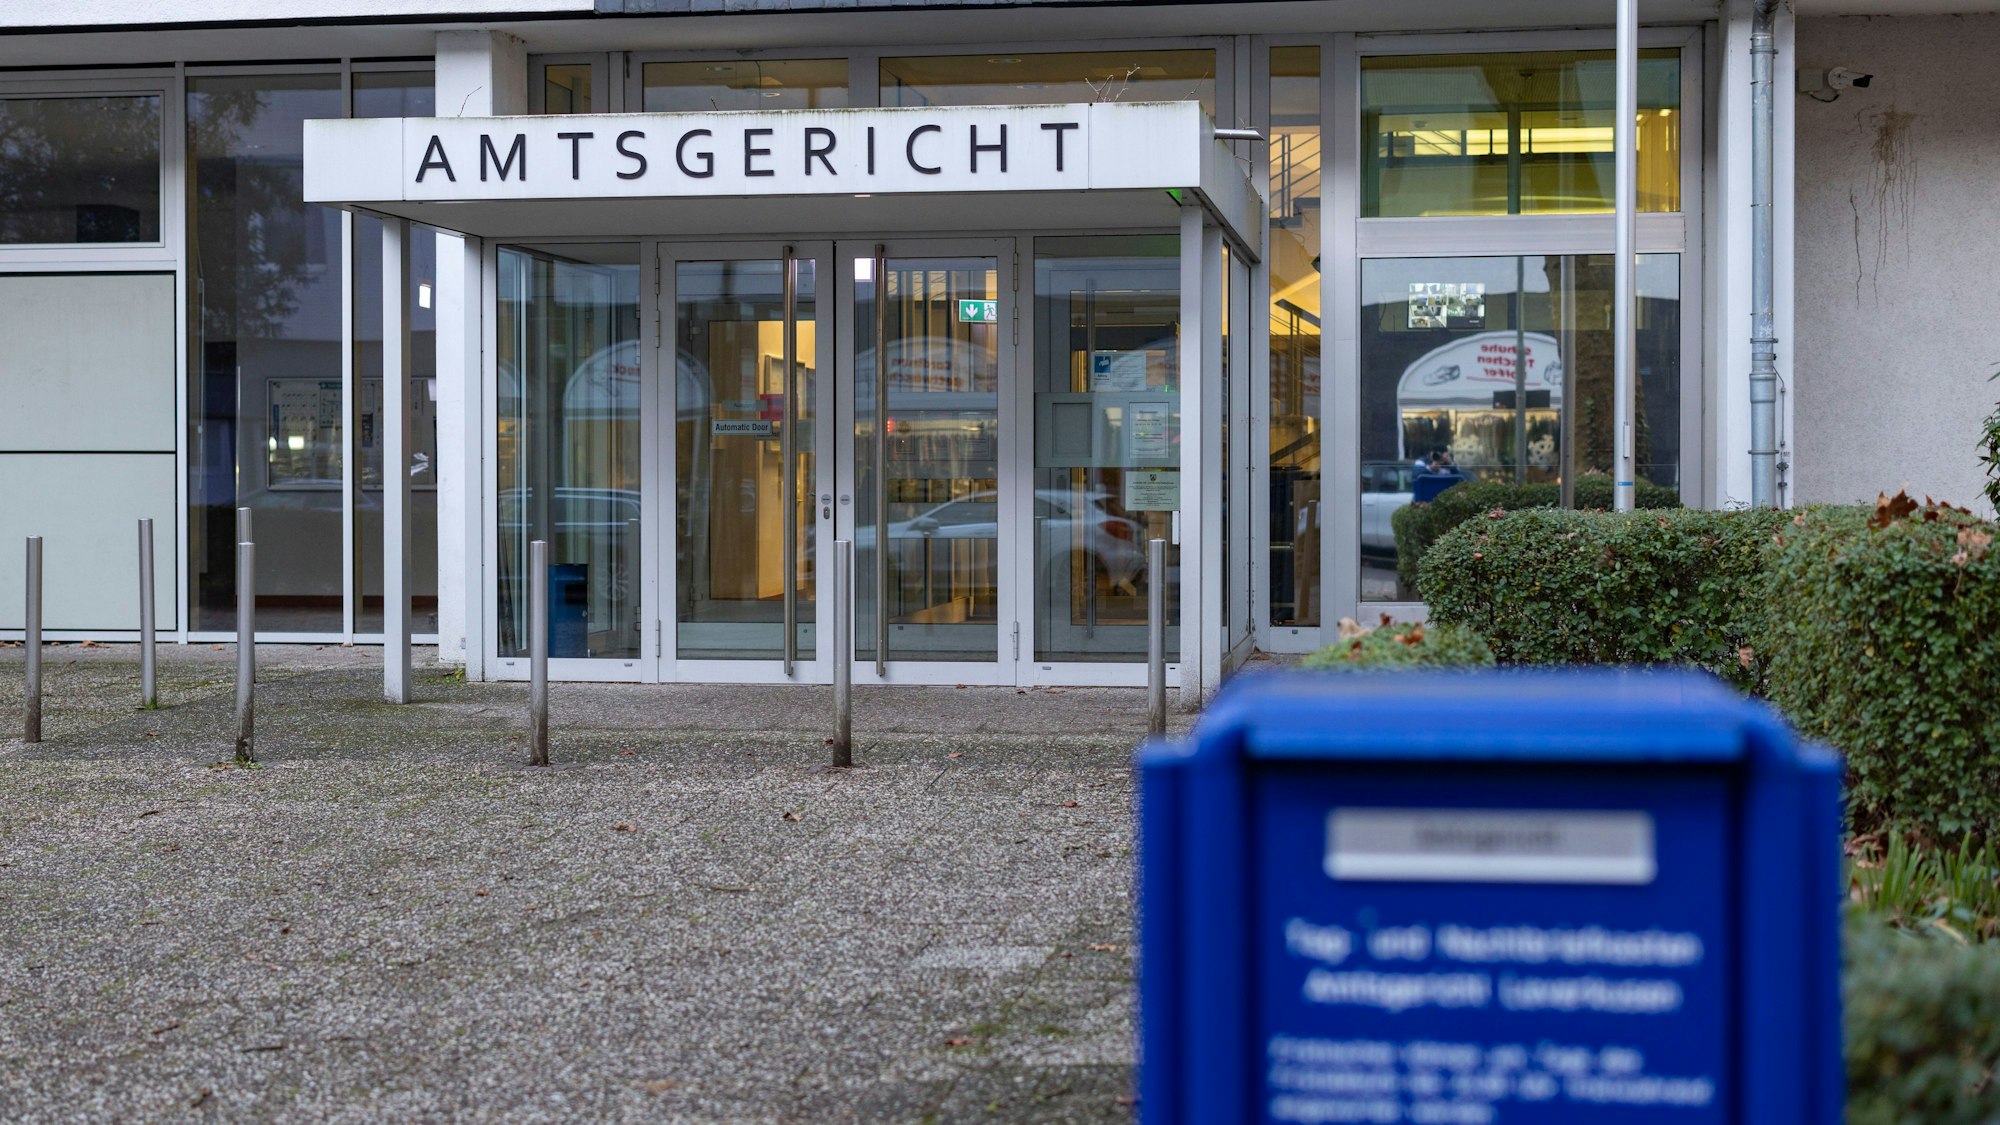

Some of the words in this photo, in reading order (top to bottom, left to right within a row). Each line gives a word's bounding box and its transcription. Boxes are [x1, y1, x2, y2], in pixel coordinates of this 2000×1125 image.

[415, 121, 1079, 183] AMTSGERICHT
[715, 423, 750, 431] Automatic
[752, 423, 769, 431] Door
